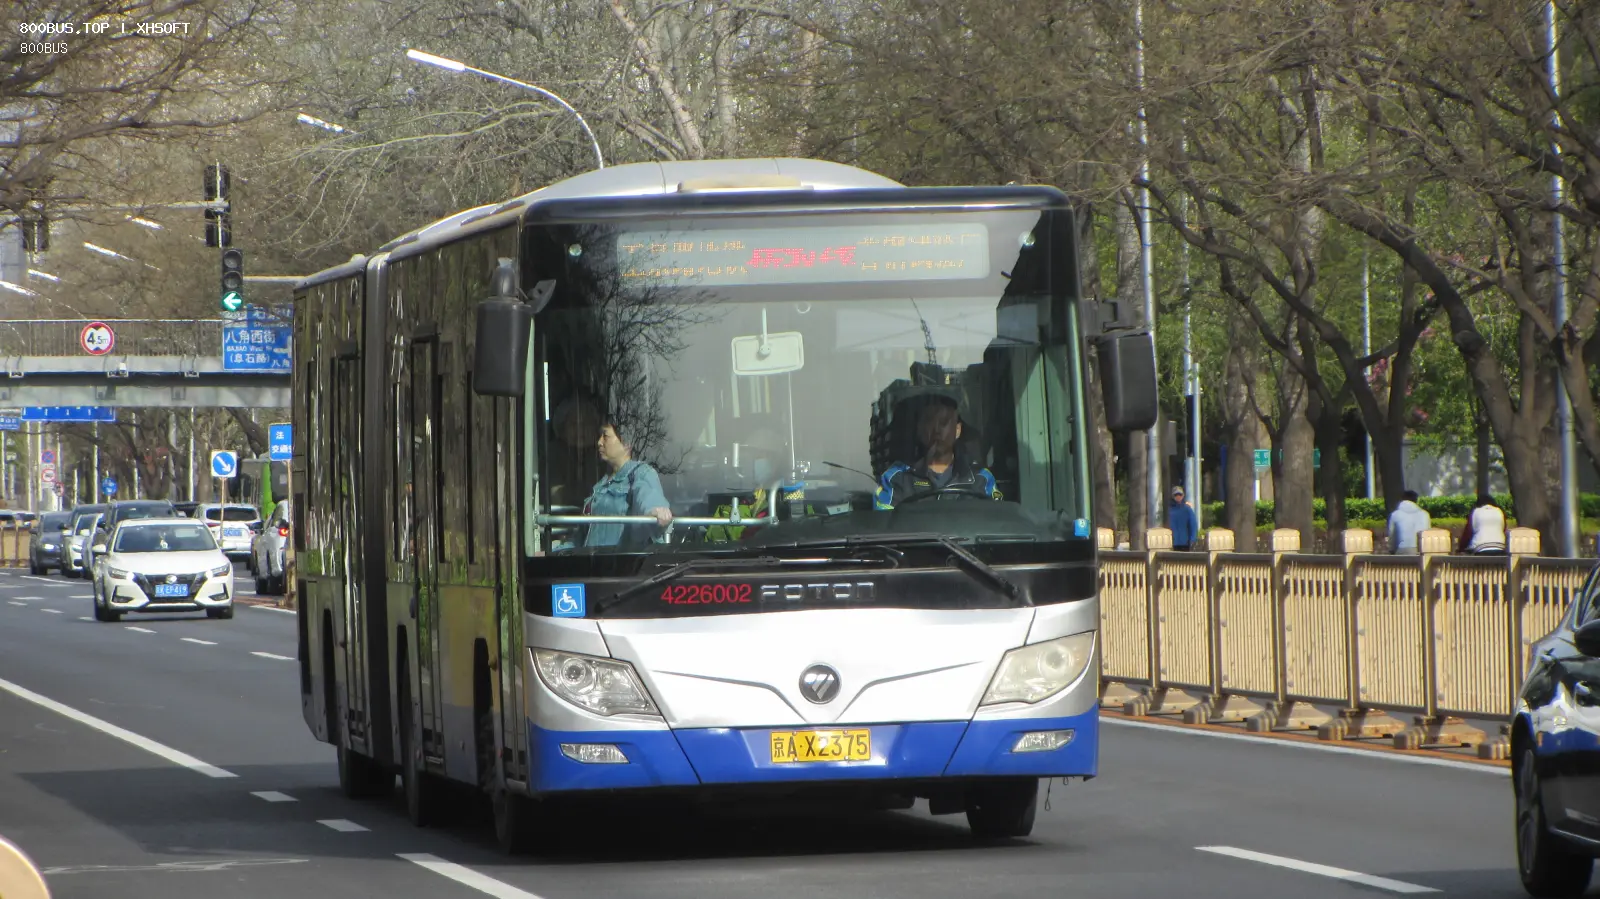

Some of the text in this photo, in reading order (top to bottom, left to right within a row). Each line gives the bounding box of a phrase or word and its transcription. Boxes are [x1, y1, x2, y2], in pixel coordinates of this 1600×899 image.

[225, 329, 276, 344] 八角西街
[660, 582, 875, 605] 4226002 FOTON
